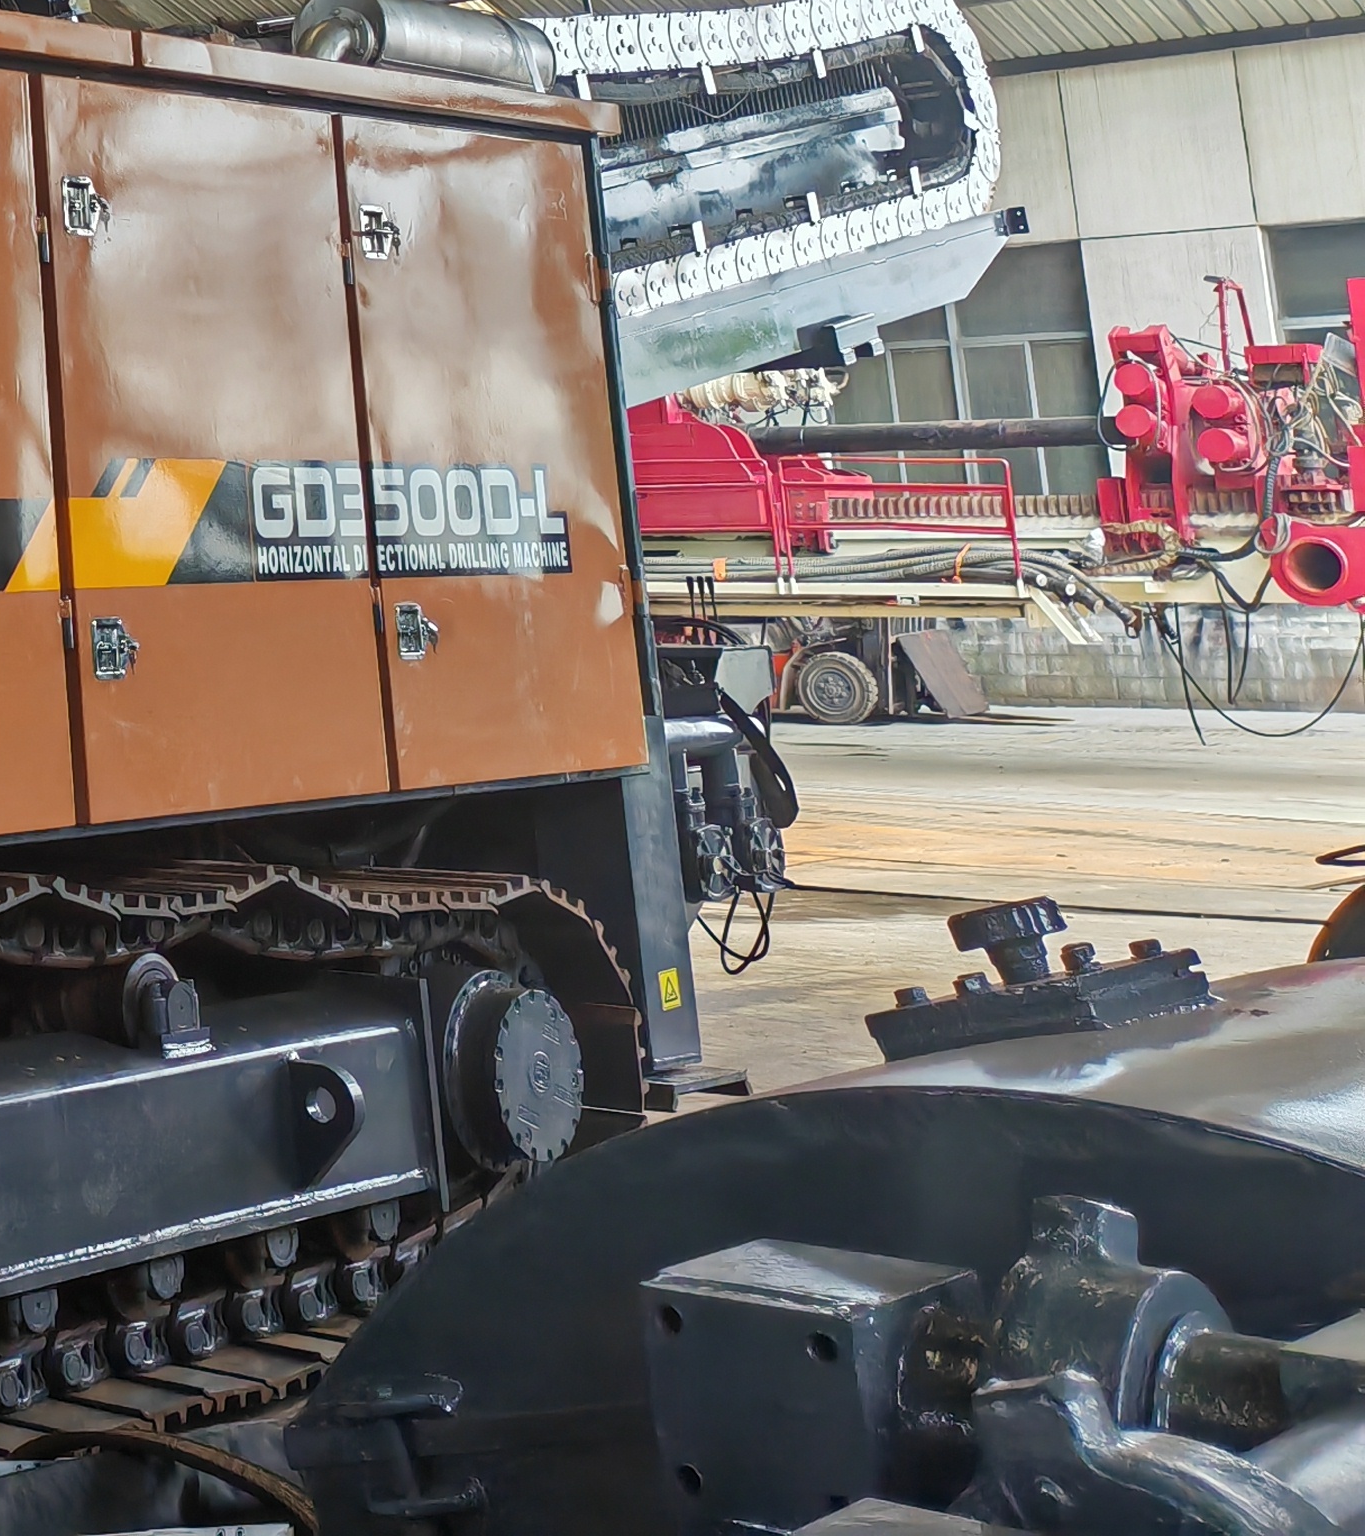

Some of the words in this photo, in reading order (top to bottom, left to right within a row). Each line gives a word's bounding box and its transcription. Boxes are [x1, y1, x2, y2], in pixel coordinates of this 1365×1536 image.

[257, 544, 351, 574] HORIZONTAL
[353, 542, 446, 572] DIECTIONAL
[448, 541, 509, 570] DRILLING
[512, 541, 569, 569] MACHINE
